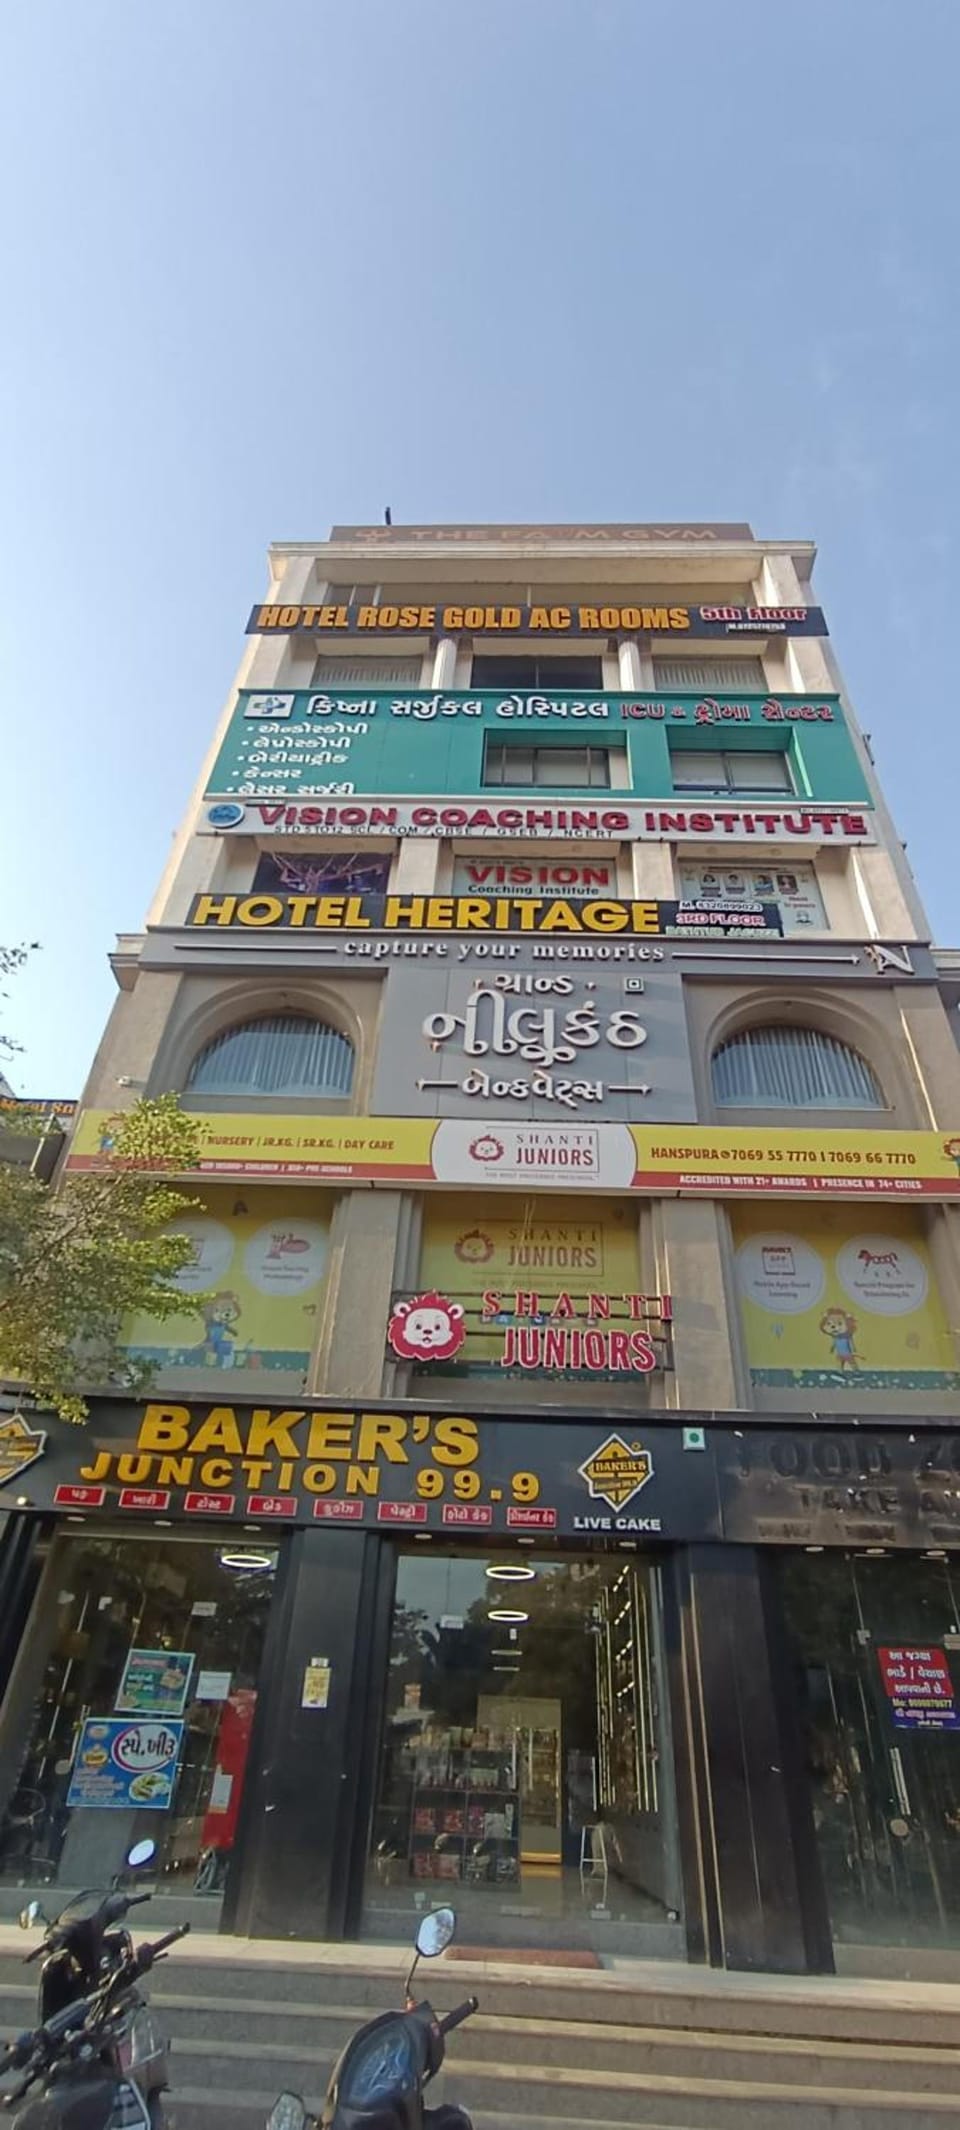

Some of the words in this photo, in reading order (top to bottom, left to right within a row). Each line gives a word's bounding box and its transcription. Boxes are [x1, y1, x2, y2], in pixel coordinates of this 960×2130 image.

[411, 530, 488, 540] THE
[502, 530, 609, 540] FAM
[622, 529, 718, 540] GYM
[256, 605, 350, 628] HOTEL
[356, 606, 436, 629] ROSE
[442, 607, 522, 630] GOLD
[529, 607, 571, 629] AC
[579, 607, 690, 630] ROOMS
[700, 606, 743, 621] 5th
[495, 695, 610, 718] હોસ્પિટલ
[621, 703, 666, 720] ICU
[257, 804, 397, 826] VISION
[411, 806, 629, 831] COACHING
[645, 812, 869, 836] INSTITUTE
[388, 826, 418, 835] COM
[464, 864, 610, 885] VISION
[468, 884, 535, 896] Coaching
[539, 885, 600, 896] Institute
[192, 895, 370, 928] HOTEL
[384, 897, 660, 934] HERITAGE
[709, 913, 767, 927] FLOOR
[344, 940, 448, 960] capture
[457, 943, 522, 962] your
[532, 941, 666, 962] memories
[207, 1136, 255, 1146] NURSERY
[344, 1140, 364, 1150] DAY
[368, 1140, 395, 1150] CARE
[515, 1133, 594, 1146] SHANTI
[515, 1147, 594, 1167] JUNIORS
[650, 1147, 720, 1161] HANSPURA
[730, 1148, 764, 1161] 7069
[767, 1149, 784, 1162] 55
[787, 1150, 817, 1163] 7770
[829, 1150, 862, 1164] 7069
[865, 1152, 883, 1164] 66
[886, 1152, 917, 1165] 7770
[679, 1173, 731, 1185] ACCREDITED
[732, 1174, 754, 1186] WITH
[895, 1179, 923, 1190] CITIES
[507, 1227, 598, 1242] SHANTI
[507, 1246, 598, 1268] JUNIORS
[481, 1288, 673, 1321] SHANTI
[501, 1327, 657, 1373] JUNIORS
[80, 1451, 381, 1496] JUNCTION
[416, 1468, 540, 1502] 99.9
[573, 1516, 612, 1529] LIVE
[615, 1518, 662, 1531] CAKE
